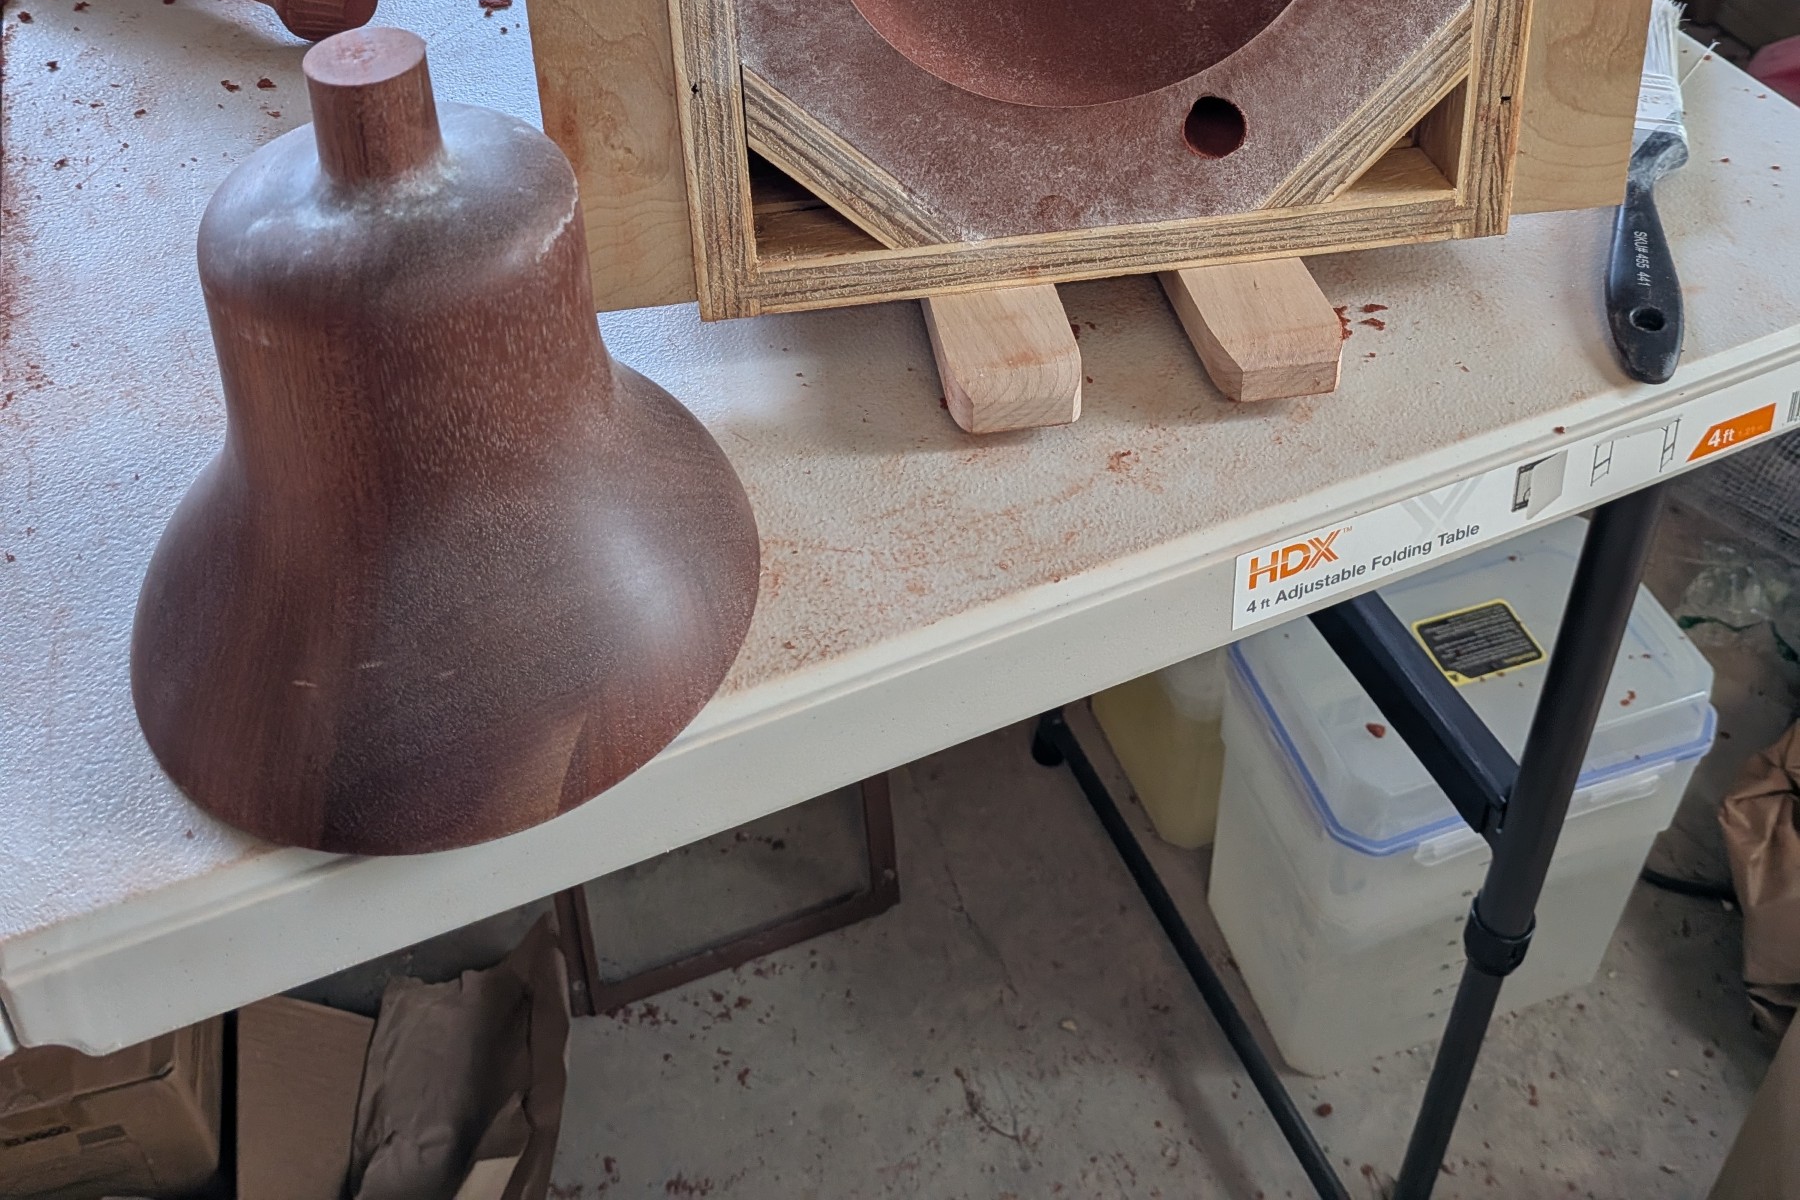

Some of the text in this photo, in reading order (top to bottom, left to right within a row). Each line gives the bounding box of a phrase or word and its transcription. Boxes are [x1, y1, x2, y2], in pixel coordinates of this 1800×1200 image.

[1633, 230, 1651, 287] SKU# 455 441
[1707, 429, 1721, 447] 4
[1722, 428, 1735, 444] ft
[1246, 524, 1480, 614] 4 ft Adjustable Folding Table
[1247, 528, 1342, 591] HDX
